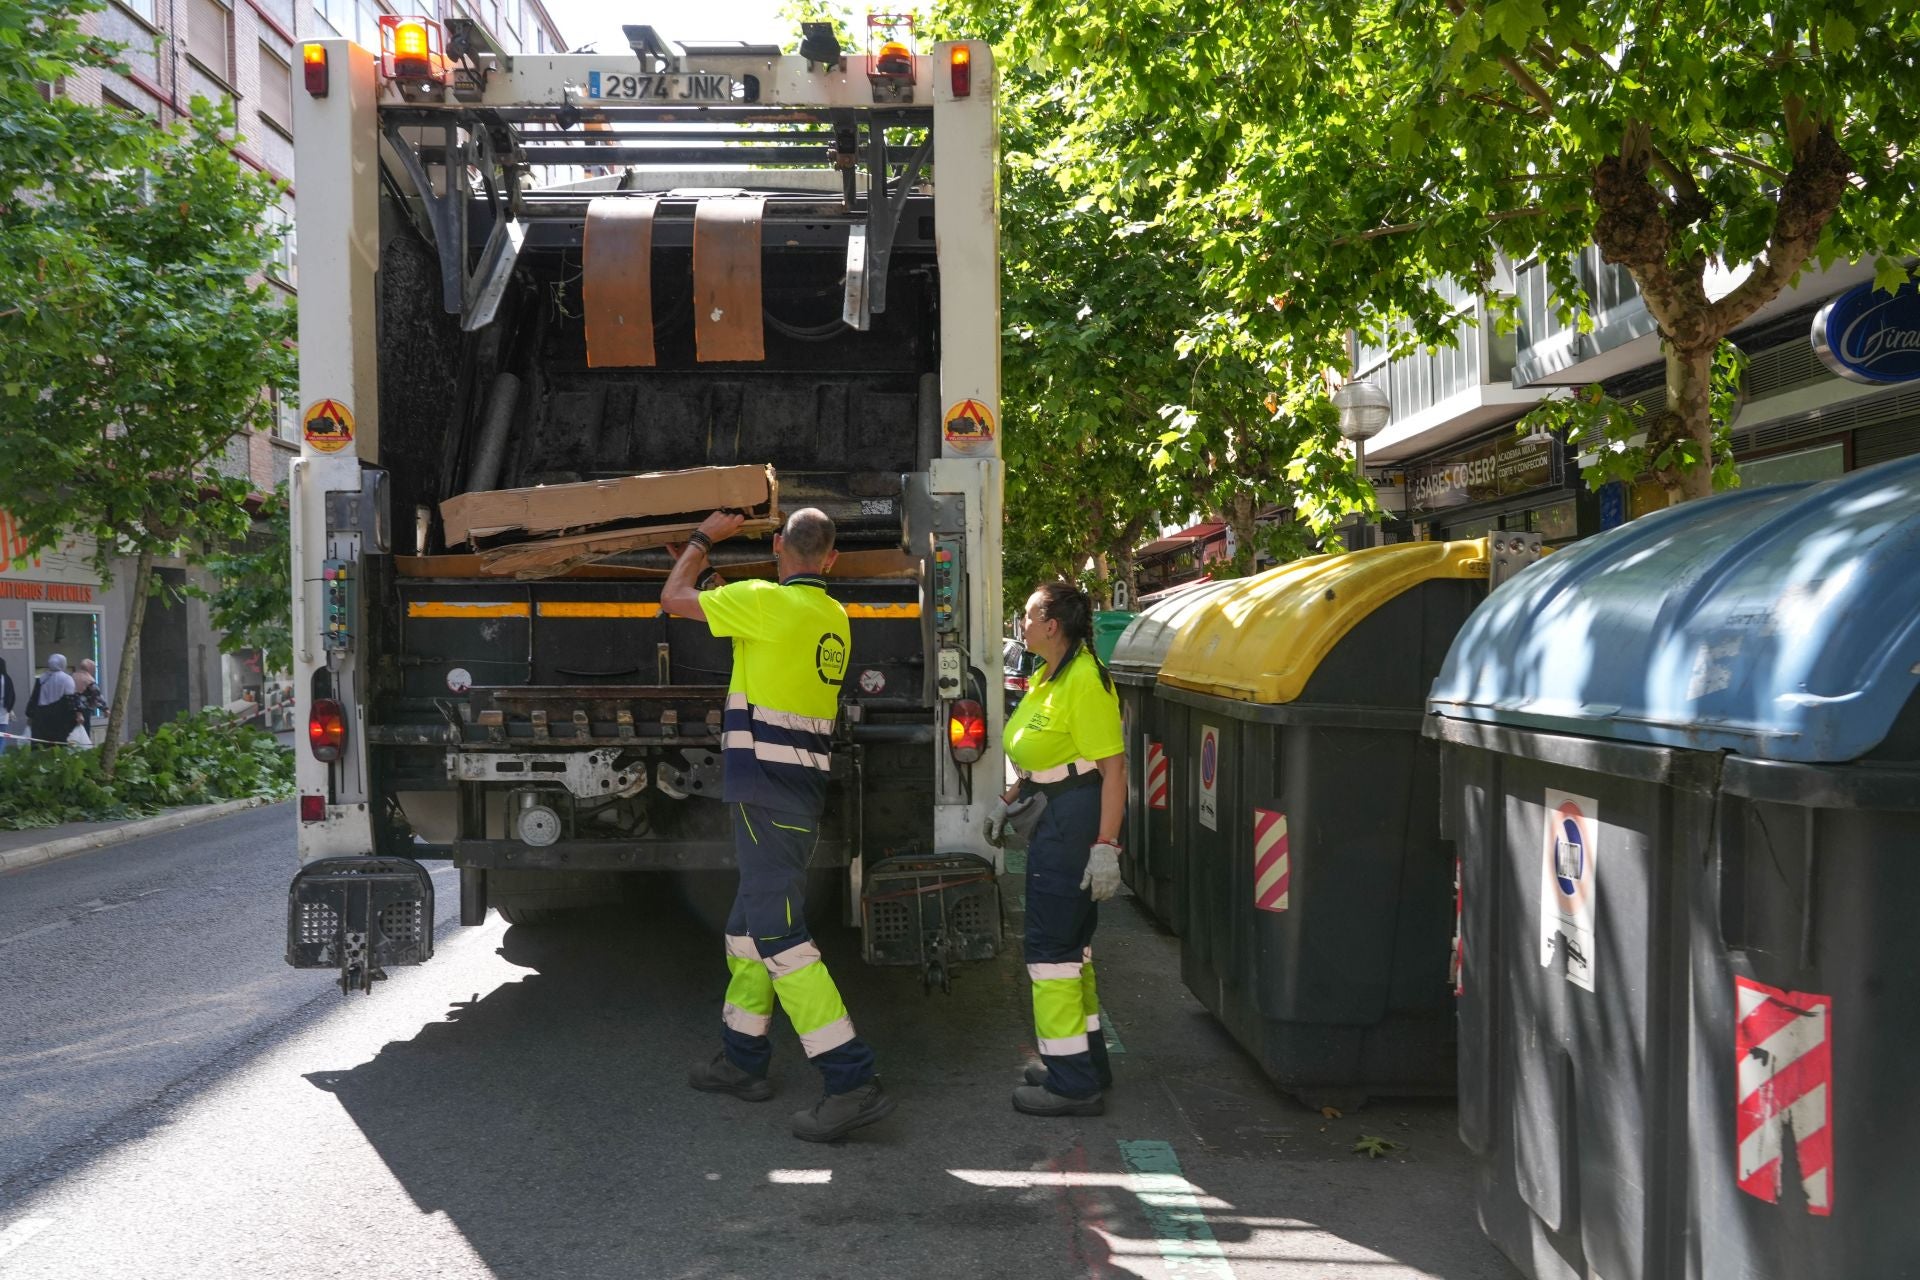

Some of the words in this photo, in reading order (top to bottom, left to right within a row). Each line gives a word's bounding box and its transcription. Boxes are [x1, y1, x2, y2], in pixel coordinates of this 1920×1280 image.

[606, 75, 668, 98] 2974
[679, 76, 725, 99] JNK
[1498, 448, 1521, 461] ACADEMIA
[1522, 444, 1536, 456] MIXTA
[1415, 469, 1450, 500] ¿SABES
[1453, 455, 1496, 489] COSER?
[1498, 466, 1513, 478] CORTE
[1518, 455, 1548, 473] CONFECCIÓN
